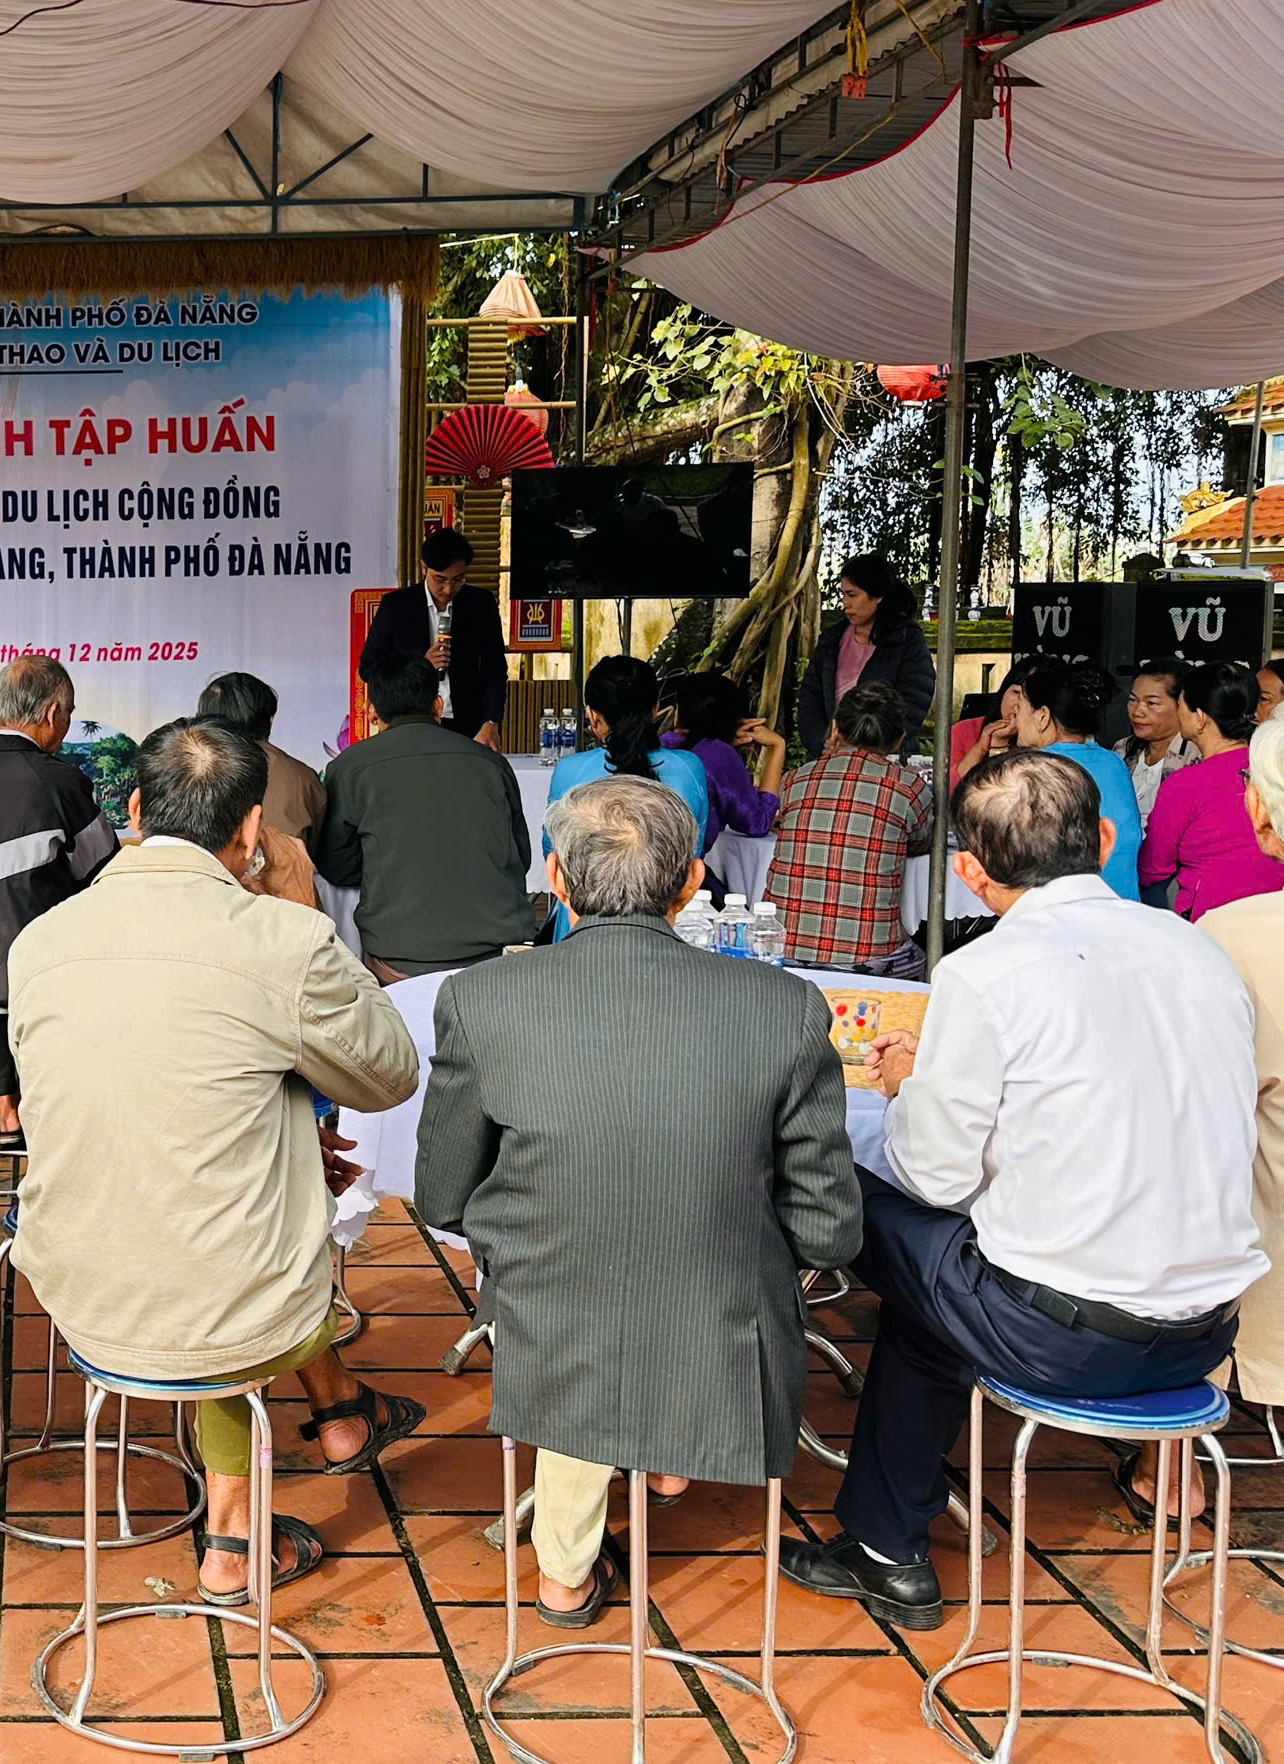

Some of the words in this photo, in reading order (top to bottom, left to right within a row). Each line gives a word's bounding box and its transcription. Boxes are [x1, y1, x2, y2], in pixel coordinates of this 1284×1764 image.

[71, 298, 126, 327] PHỐ
[134, 301, 173, 325] ĐÀ
[180, 295, 258, 324] NẴNG
[74, 338, 110, 363] VÀ
[119, 342, 153, 362] DU
[162, 341, 220, 367] LỊCH
[49, 408, 131, 466] TẬP
[148, 398, 275, 454] HUẤN
[2, 490, 37, 522] DU
[47, 489, 109, 529] LỊCH
[118, 481, 194, 528] CỘNG
[203, 475, 280, 519] ĐỒNG
[63, 540, 155, 579] THÀNH
[165, 532, 220, 577] PHỐ
[228, 536, 265, 576] ĐÀ
[274, 530, 351, 575] NẴNG
[1032, 597, 1072, 637] VŨ
[1169, 596, 1226, 642] VŨ
[69, 643, 91, 662] 12
[97, 642, 142, 661] năm
[148, 642, 198, 661] 2025
